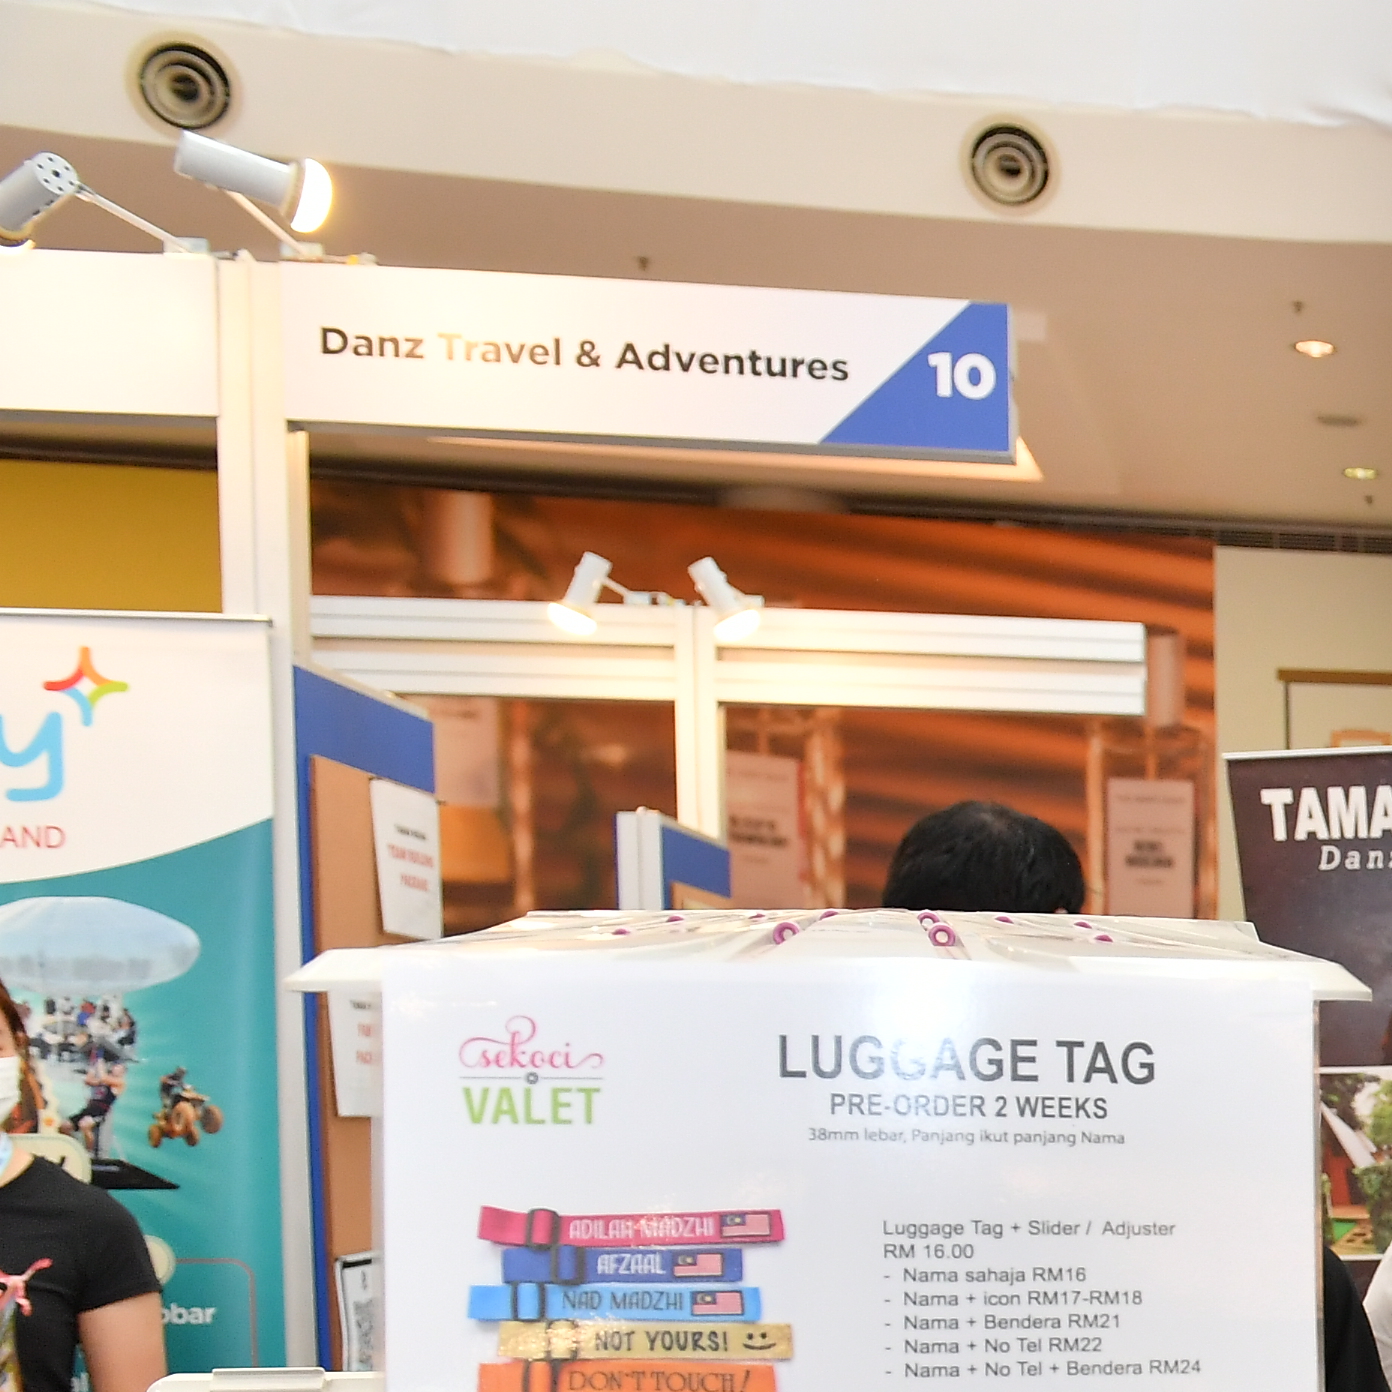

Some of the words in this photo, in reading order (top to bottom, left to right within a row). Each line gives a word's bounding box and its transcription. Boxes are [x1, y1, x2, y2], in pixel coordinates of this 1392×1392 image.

[320, 326, 424, 360] Danz
[438, 332, 562, 366] Travel
[575, 341, 601, 368] &
[615, 342, 849, 382] Adventures
[927, 350, 996, 400] 10
[778, 1033, 1040, 1083] LUGGAGE
[1056, 1040, 1155, 1085] TAG
[462, 1086, 602, 1126] VALET
[830, 1091, 987, 1119] PRE-ORDER
[993, 1095, 1008, 1118] 2
[1015, 1095, 1108, 1120] WEEKS
[808, 1127, 860, 1142] 38mm
[911, 1128, 976, 1146] Panjang
[980, 1128, 1009, 1143] ikut
[1014, 1129, 1078, 1148] panjang
[1081, 1130, 1126, 1146] Nama
[882, 1220, 964, 1239] Luggage
[971, 1220, 1004, 1239] Tag
[1028, 1220, 1081, 1237] Slider
[1101, 1221, 1176, 1240] Adjuster
[883, 1243, 916, 1259] RM
[924, 1243, 975, 1260] 16.00
[902, 1267, 959, 1283] Nama
[965, 1266, 1026, 1286] sahaja
[1032, 1266, 1087, 1283] RM16
[562, 1291, 602, 1311] NAD
[610, 1289, 684, 1311] MADZHI
[595, 1330, 635, 1352] NOT
[645, 1330, 729, 1352] YOURS!
[904, 1362, 960, 1379] Nama
[984, 1362, 1011, 1378] No
[1017, 1361, 1043, 1377] Tel
[1066, 1360, 1143, 1376] Bendera
[1149, 1359, 1202, 1376] RM24
[568, 1371, 647, 1392] DON'T
